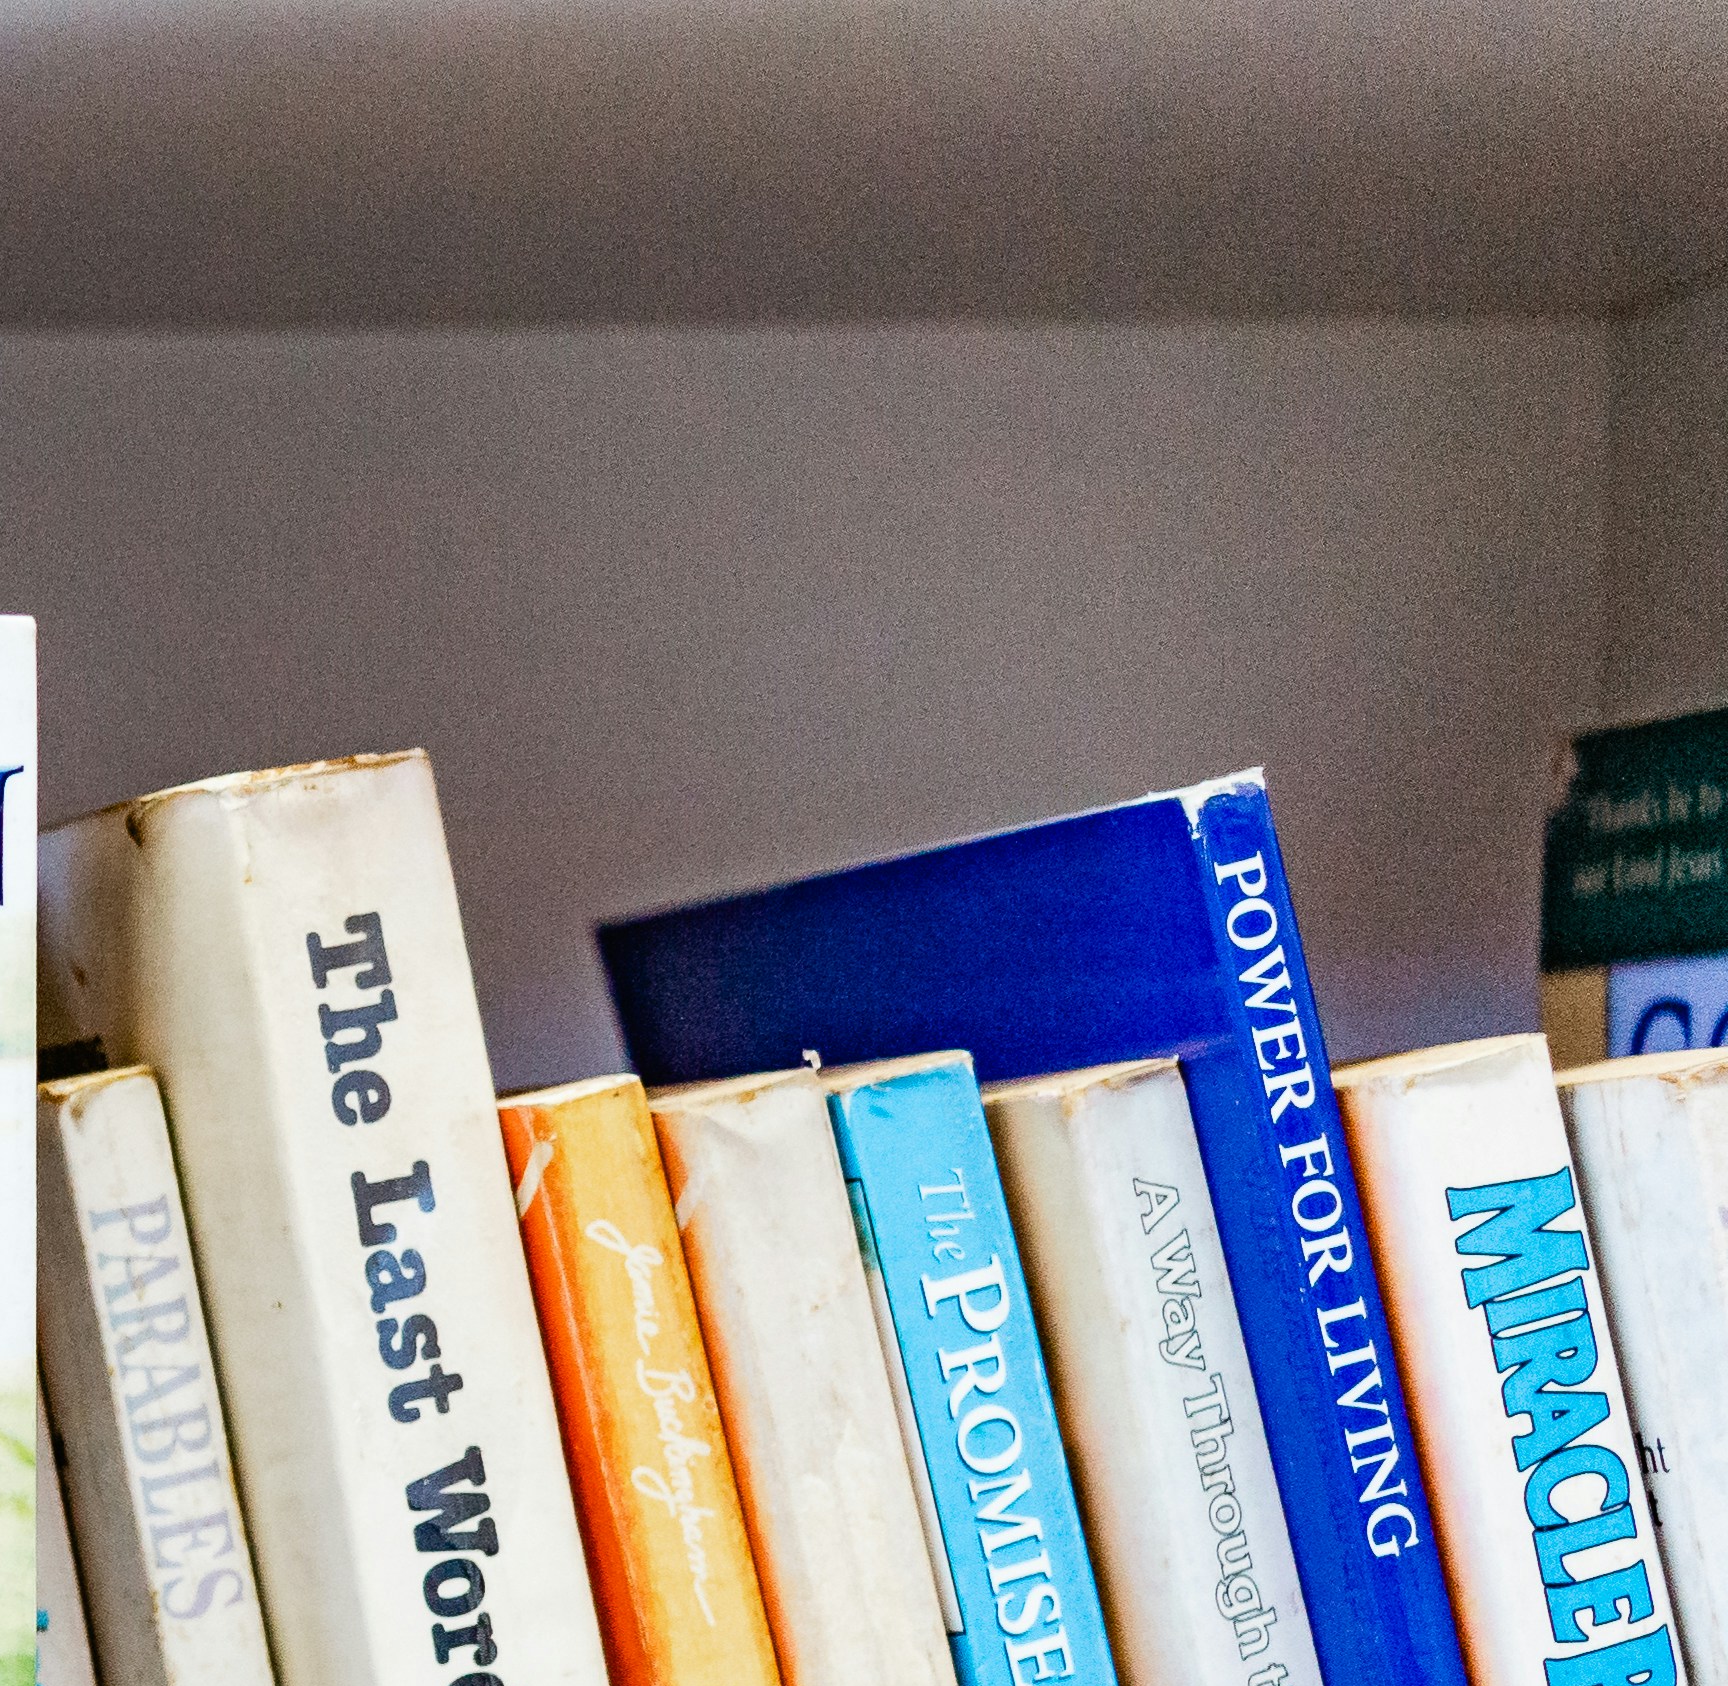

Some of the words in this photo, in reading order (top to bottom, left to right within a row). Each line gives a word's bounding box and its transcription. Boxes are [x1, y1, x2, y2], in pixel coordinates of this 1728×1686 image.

[306, 912, 399, 1128] The
[350, 1160, 464, 1425] Last
[915, 1168, 968, 1261] The
[1132, 1178, 1181, 1232] A
[1151, 1229, 1204, 1374] Way
[1214, 850, 1318, 1122] POWER
[1279, 1132, 1354, 1287] FOR
[1318, 1298, 1420, 1559] LIVING
[88, 1193, 245, 1622] PARABLES
[1183, 1373, 1270, 1661] Through
